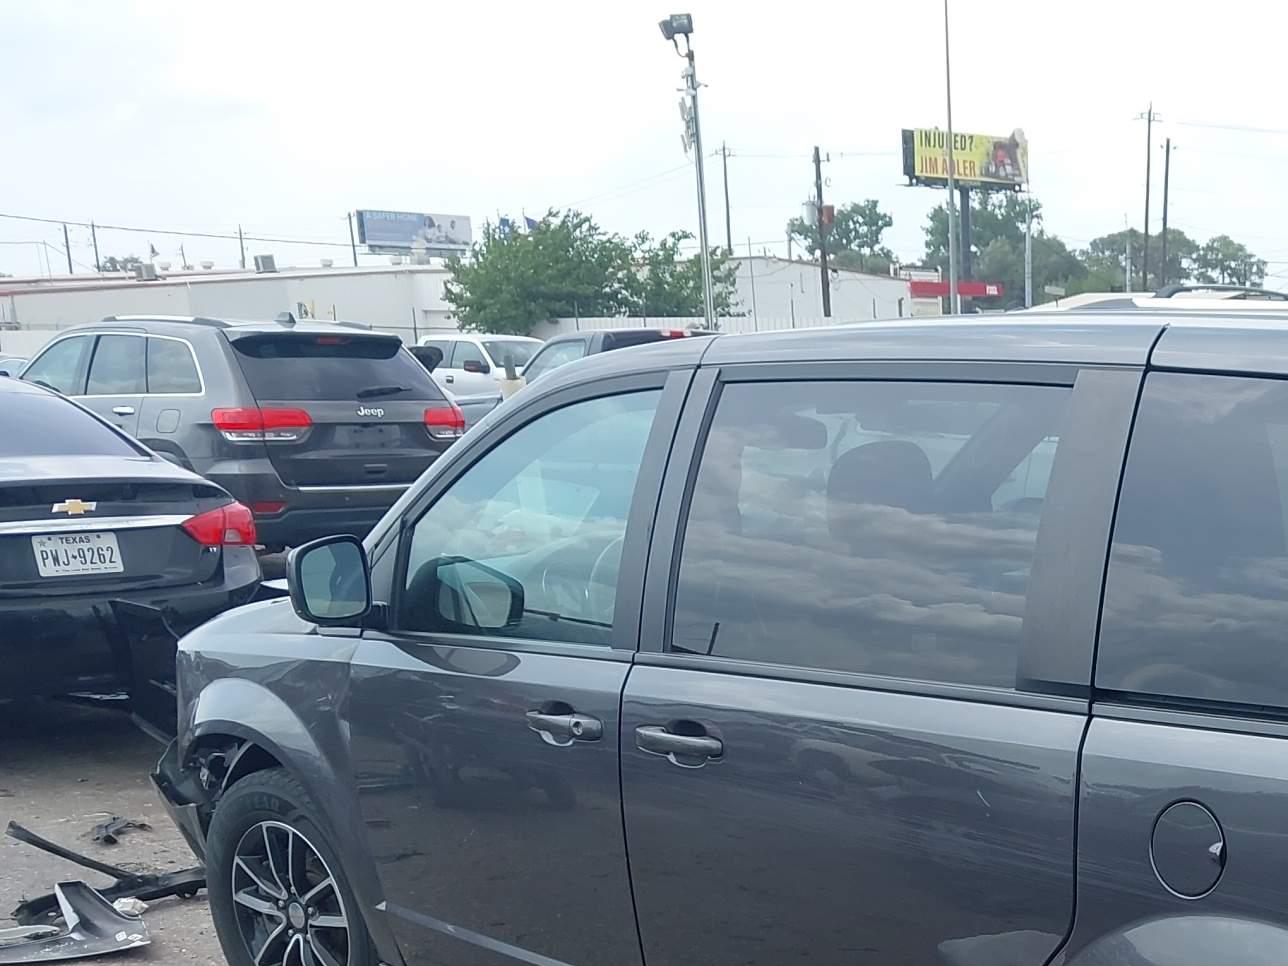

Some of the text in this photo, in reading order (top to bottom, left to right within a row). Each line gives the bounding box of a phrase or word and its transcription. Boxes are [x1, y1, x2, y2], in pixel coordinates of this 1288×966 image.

[920, 156, 938, 174] JIM
[357, 406, 385, 418] Jeep
[59, 536, 91, 545] TEXAS
[77, 546, 117, 565] 9262
